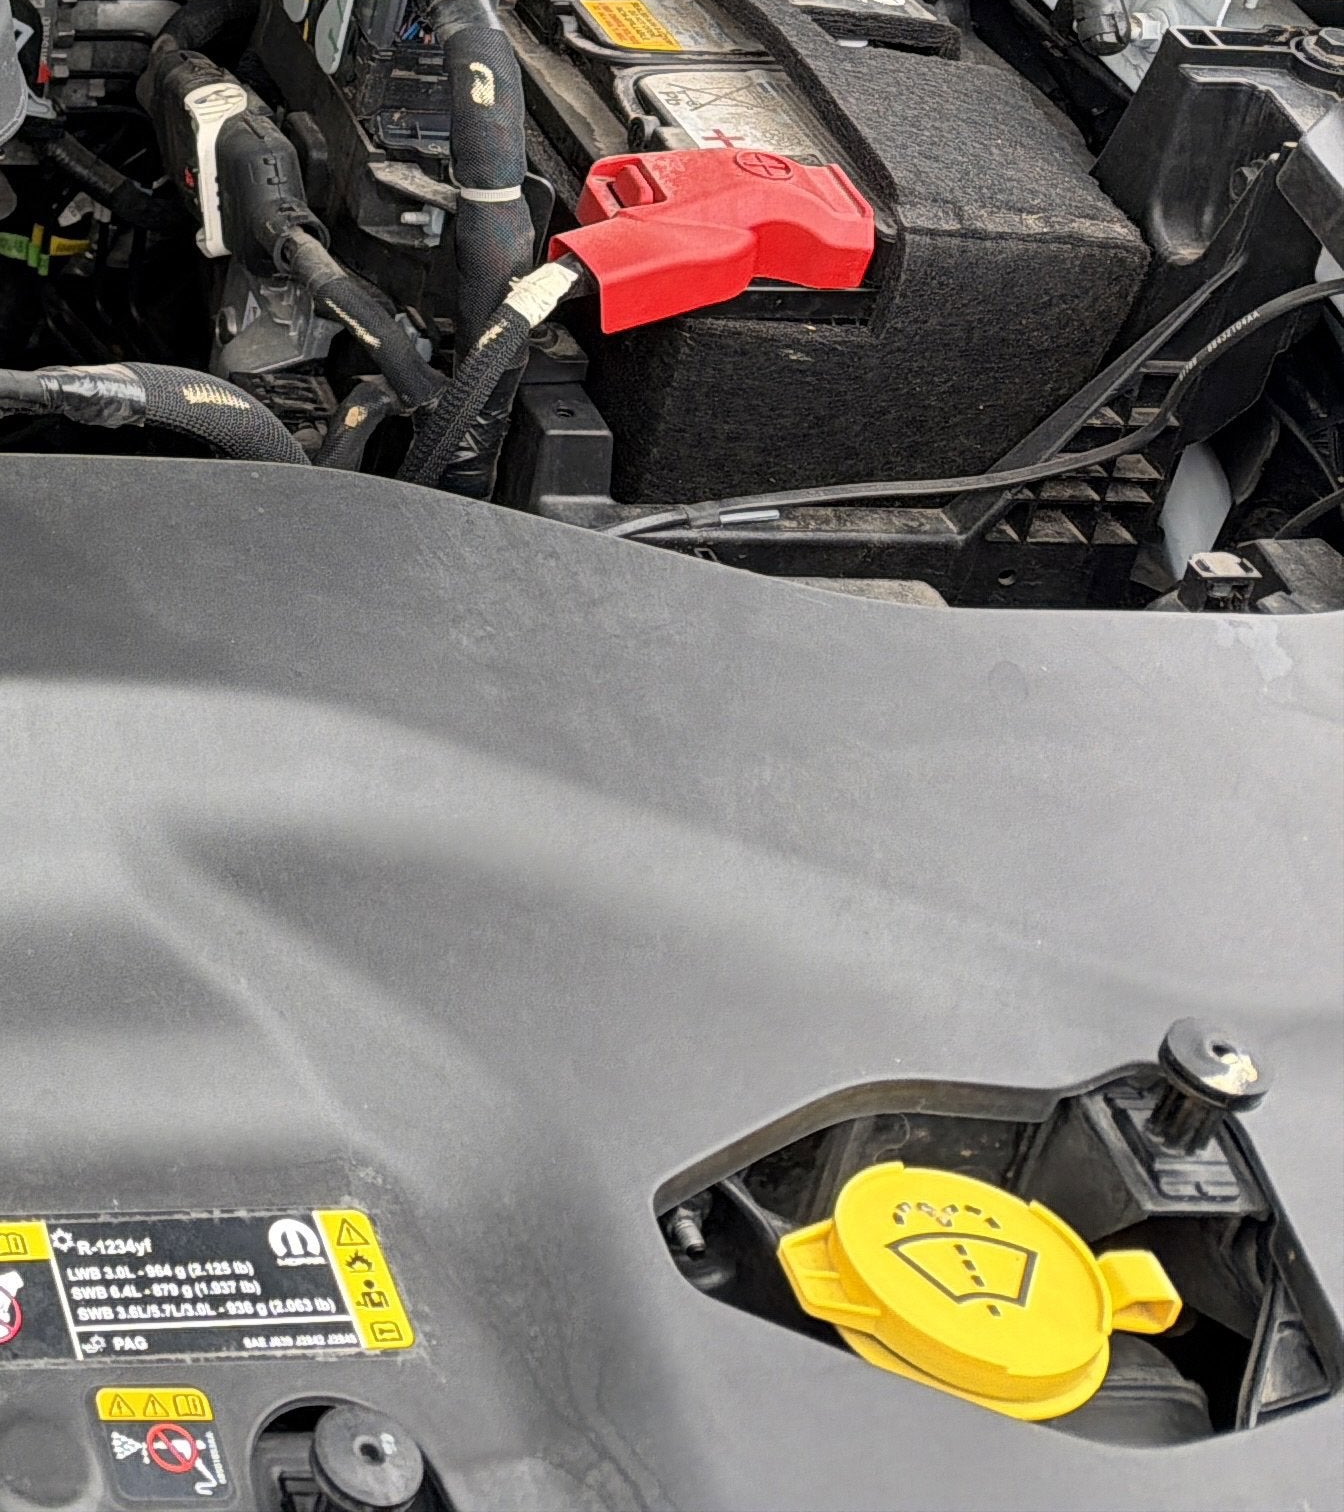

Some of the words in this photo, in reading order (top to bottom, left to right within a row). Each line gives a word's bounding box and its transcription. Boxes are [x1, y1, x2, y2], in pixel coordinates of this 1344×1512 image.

[76, 1237, 153, 1257] R-1234yf
[66, 1266, 102, 1281] LWB
[103, 1264, 137, 1280] 3.0L
[175, 1266, 188, 1280] g
[232, 1259, 255, 1277] lb)
[70, 1285, 109, 1301] SWB
[181, 1285, 194, 1300] g
[238, 1279, 262, 1296] lb)
[76, 1305, 115, 1321] SWB
[255, 1302, 269, 1317] g
[315, 1296, 337, 1314] lb)
[111, 1336, 149, 1351] PAG
